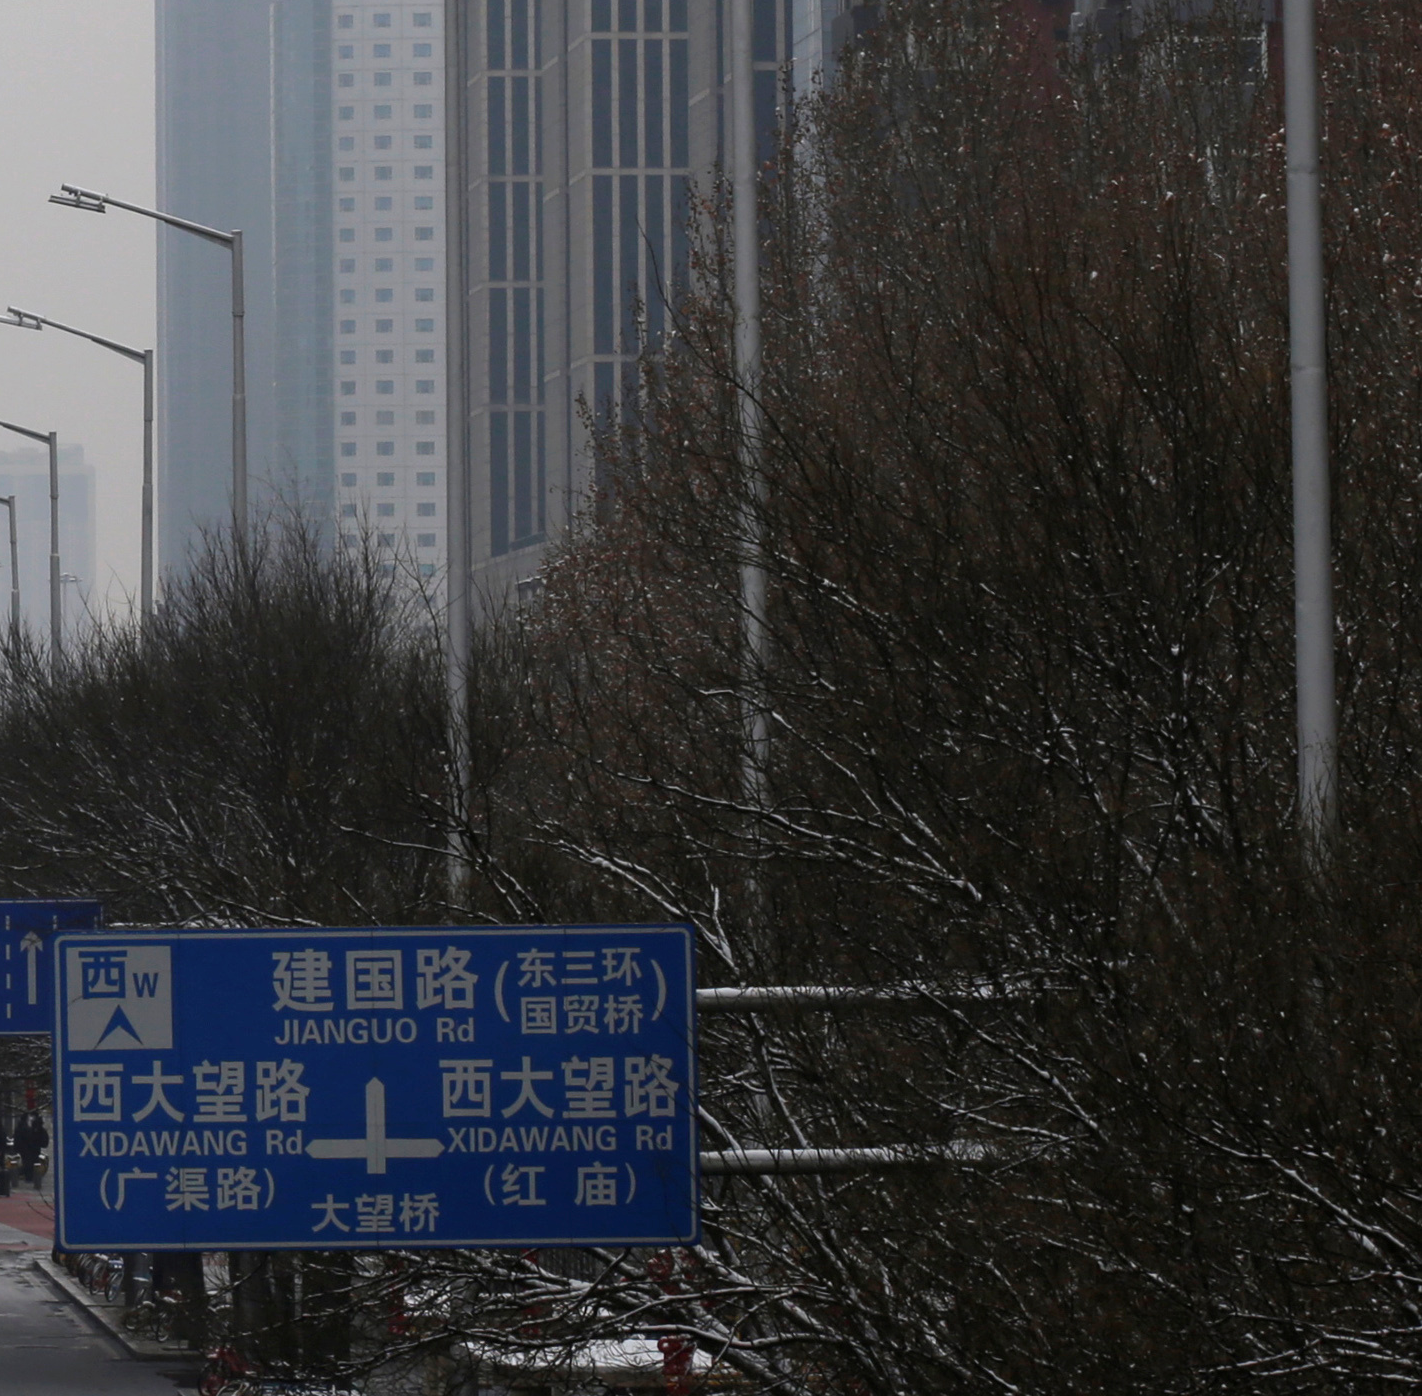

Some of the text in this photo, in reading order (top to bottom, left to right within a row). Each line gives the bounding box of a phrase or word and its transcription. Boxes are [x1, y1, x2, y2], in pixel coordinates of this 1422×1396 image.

[78, 950, 127, 999] 西
[132, 973, 159, 998] W
[272, 946, 479, 1012] 建国路
[274, 1018, 475, 1045] JIANGUO Rd
[70, 1059, 310, 1122] 西大望路
[439, 1054, 679, 1119] 西大望路
[79, 1130, 303, 1156] XIDAWANG Rd
[447, 1126, 673, 1153] XIDAWANG Rd
[100, 1167, 275, 1211] (广渠路)
[311, 1192, 440, 1233] 大望桥
